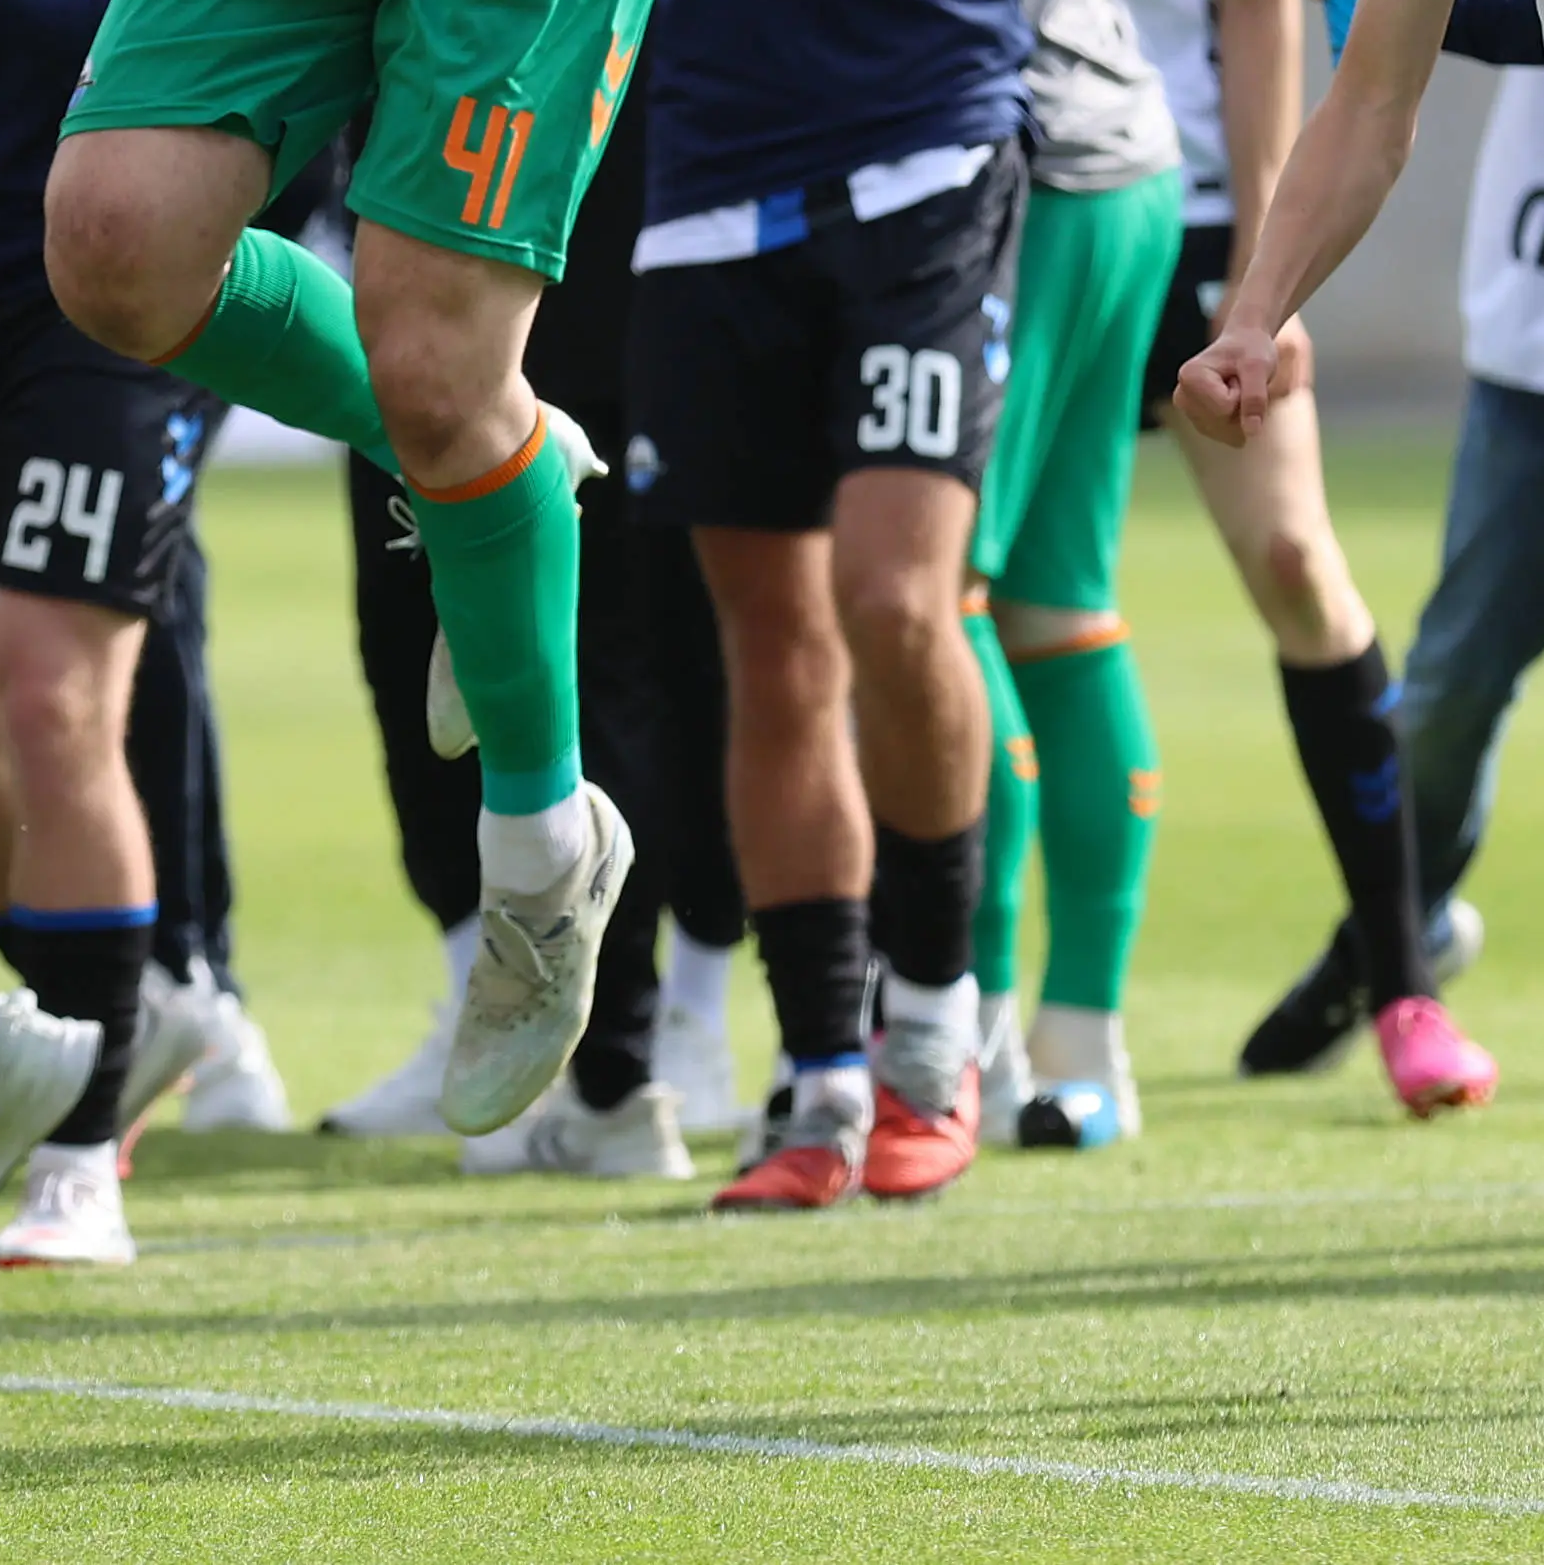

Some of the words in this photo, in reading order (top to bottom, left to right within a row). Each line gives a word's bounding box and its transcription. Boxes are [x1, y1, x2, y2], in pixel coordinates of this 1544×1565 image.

[442, 95, 536, 230] 41
[856, 343, 963, 460] 30
[1, 455, 125, 584] 24
